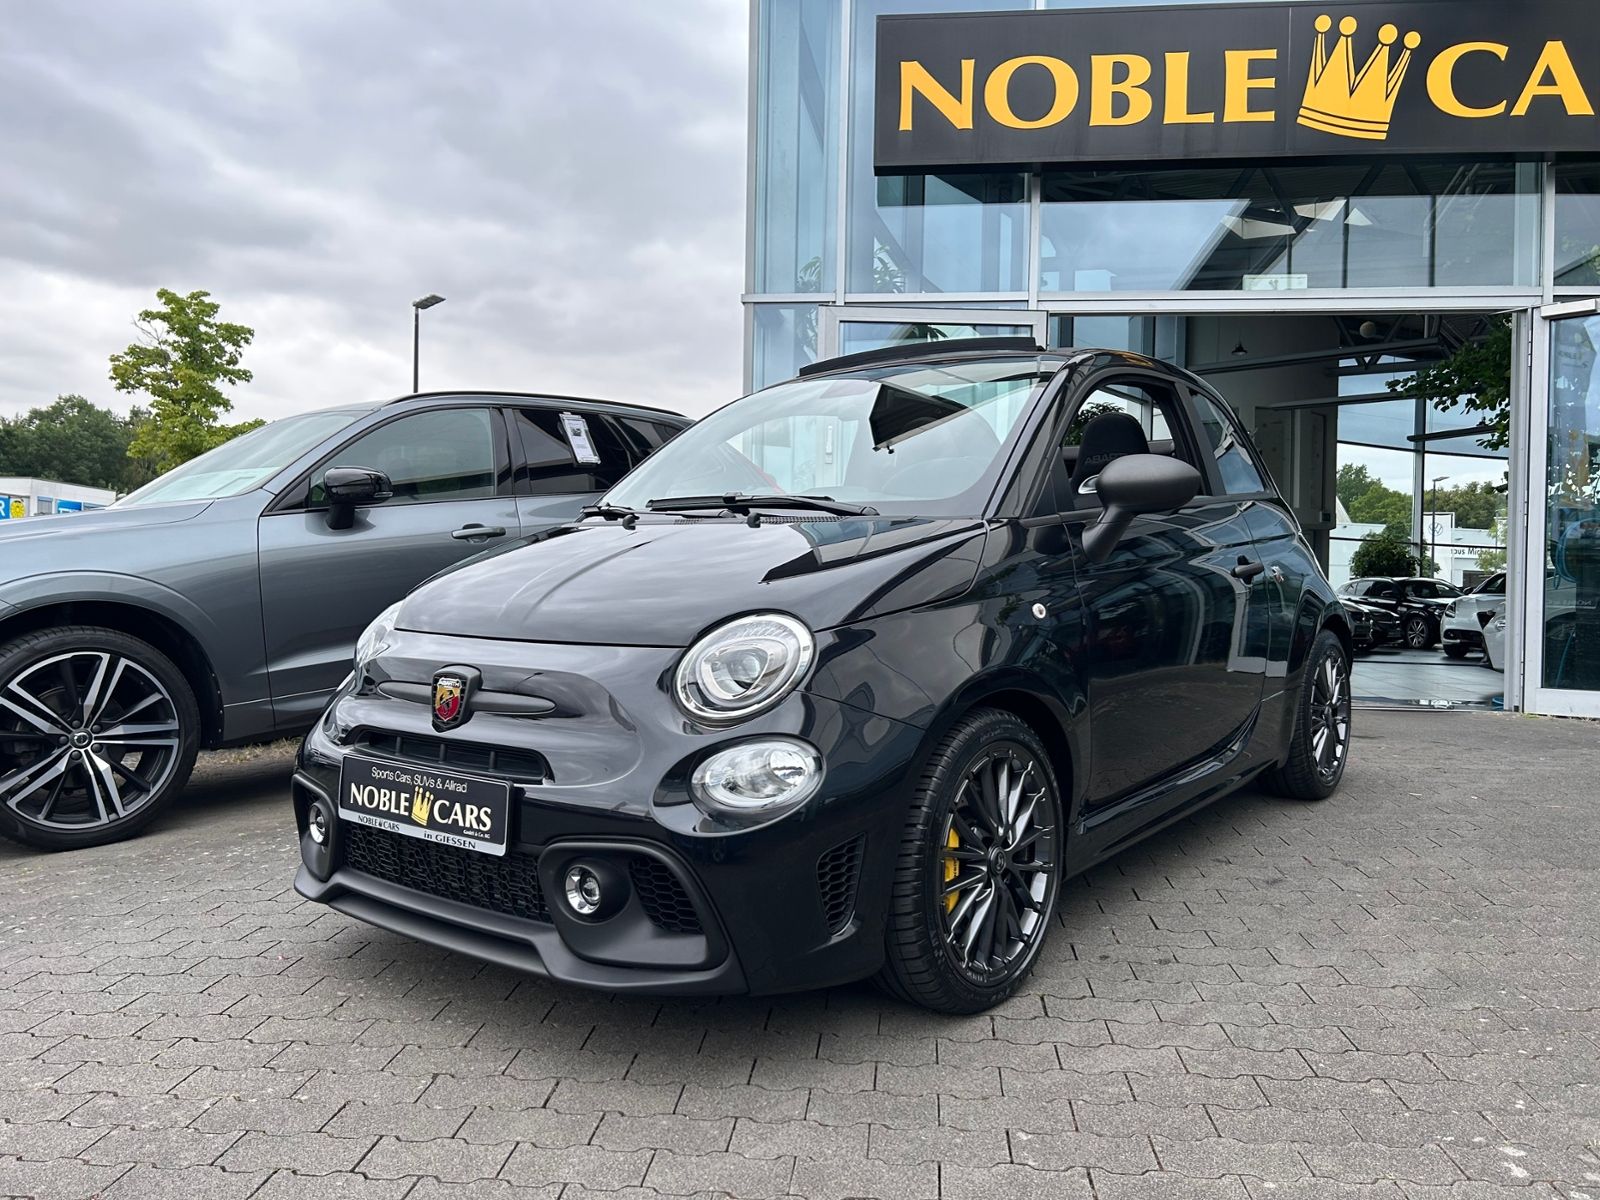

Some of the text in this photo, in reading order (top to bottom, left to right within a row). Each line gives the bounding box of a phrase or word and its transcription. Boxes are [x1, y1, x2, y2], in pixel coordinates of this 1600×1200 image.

[898, 40, 1595, 131] NOBLE CA
[371, 766, 468, 793] Sports Cars, SUVs & Allrad
[350, 782, 492, 832] NOBLE CARS
[358, 815, 400, 832] NOBLE CARS
[423, 830, 476, 849] in GIESSEN
